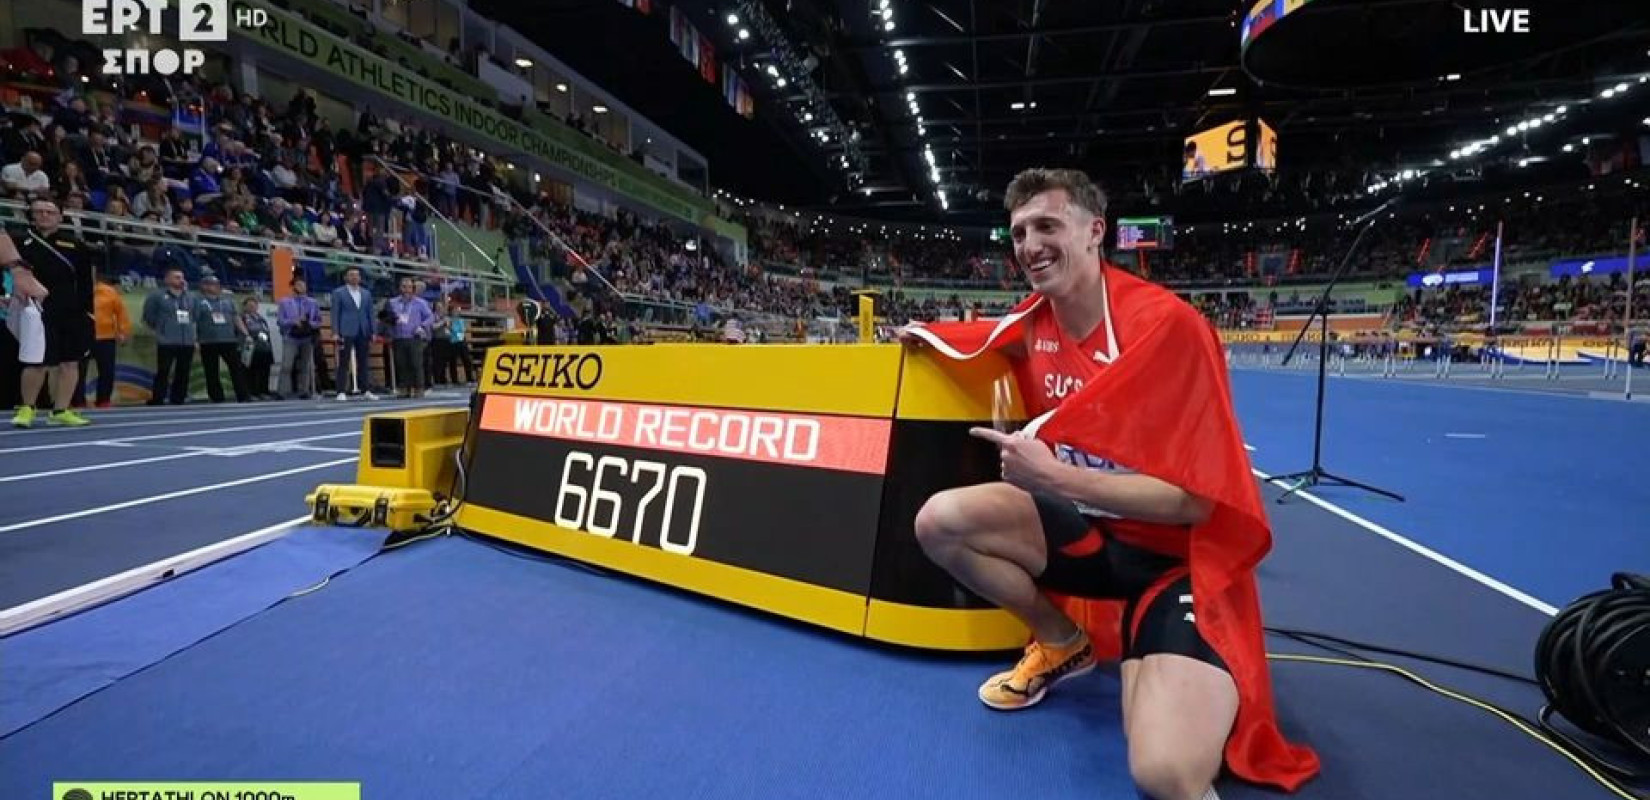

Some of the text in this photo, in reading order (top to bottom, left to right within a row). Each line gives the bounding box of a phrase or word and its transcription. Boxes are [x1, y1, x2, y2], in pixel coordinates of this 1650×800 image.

[231, 2, 318, 57] ORLD
[327, 45, 450, 116] ATHLETICS
[455, 101, 518, 143] INDOOR
[493, 352, 602, 390] SEIKO
[513, 399, 821, 461] WORLD RECORD
[554, 451, 707, 556] 6670
